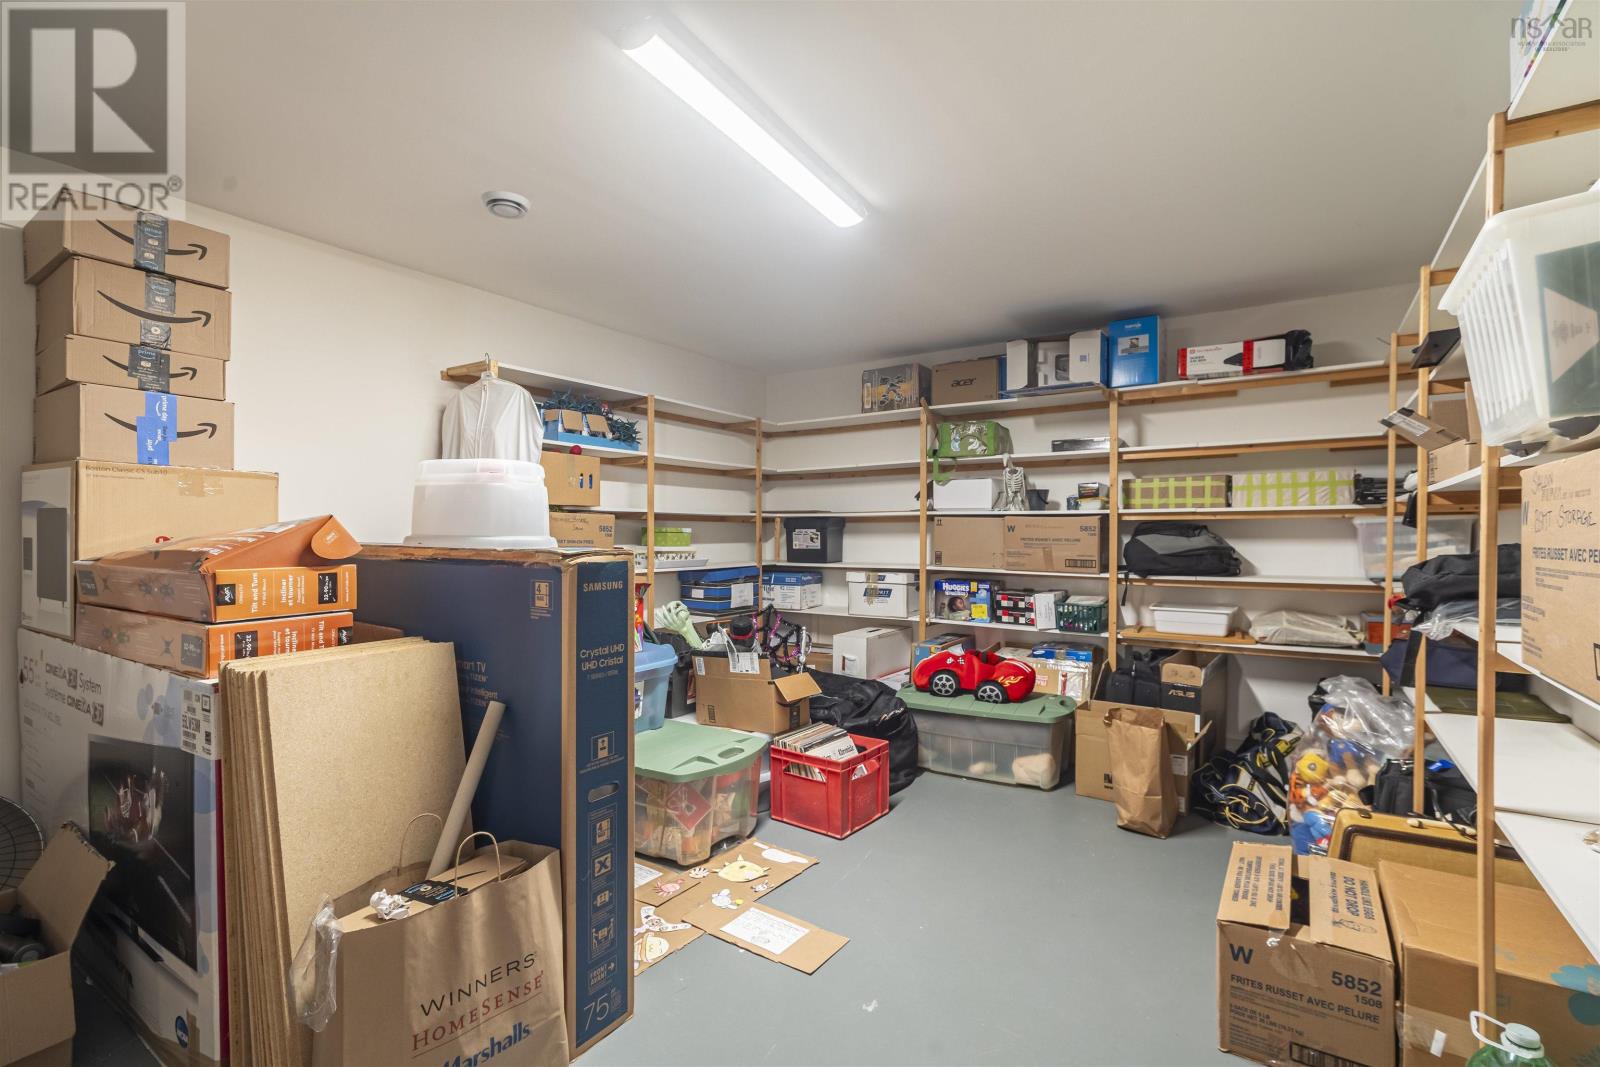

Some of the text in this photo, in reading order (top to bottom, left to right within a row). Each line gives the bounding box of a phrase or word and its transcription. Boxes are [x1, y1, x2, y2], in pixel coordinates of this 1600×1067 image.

[950, 377, 976, 388] acer
[1569, 548, 1586, 562] AVEC
[582, 581, 624, 592] SAMSUNG
[580, 644, 624, 660] Crystal UHD
[476, 662, 486, 672] TV
[582, 656, 624, 671] UHD Cristal
[80, 676, 102, 696] System
[66, 695, 91, 714] CINEMA
[1230, 944, 1254, 964] W
[420, 953, 536, 1017] WINNERS
[1331, 971, 1382, 997] 5852
[1230, 974, 1262, 991] FRITES
[1265, 984, 1304, 1002] RUSSET
[1306, 996, 1336, 1010] AVEC
[1336, 1004, 1380, 1025] PELURE
[1354, 994, 1384, 1008] 1508
